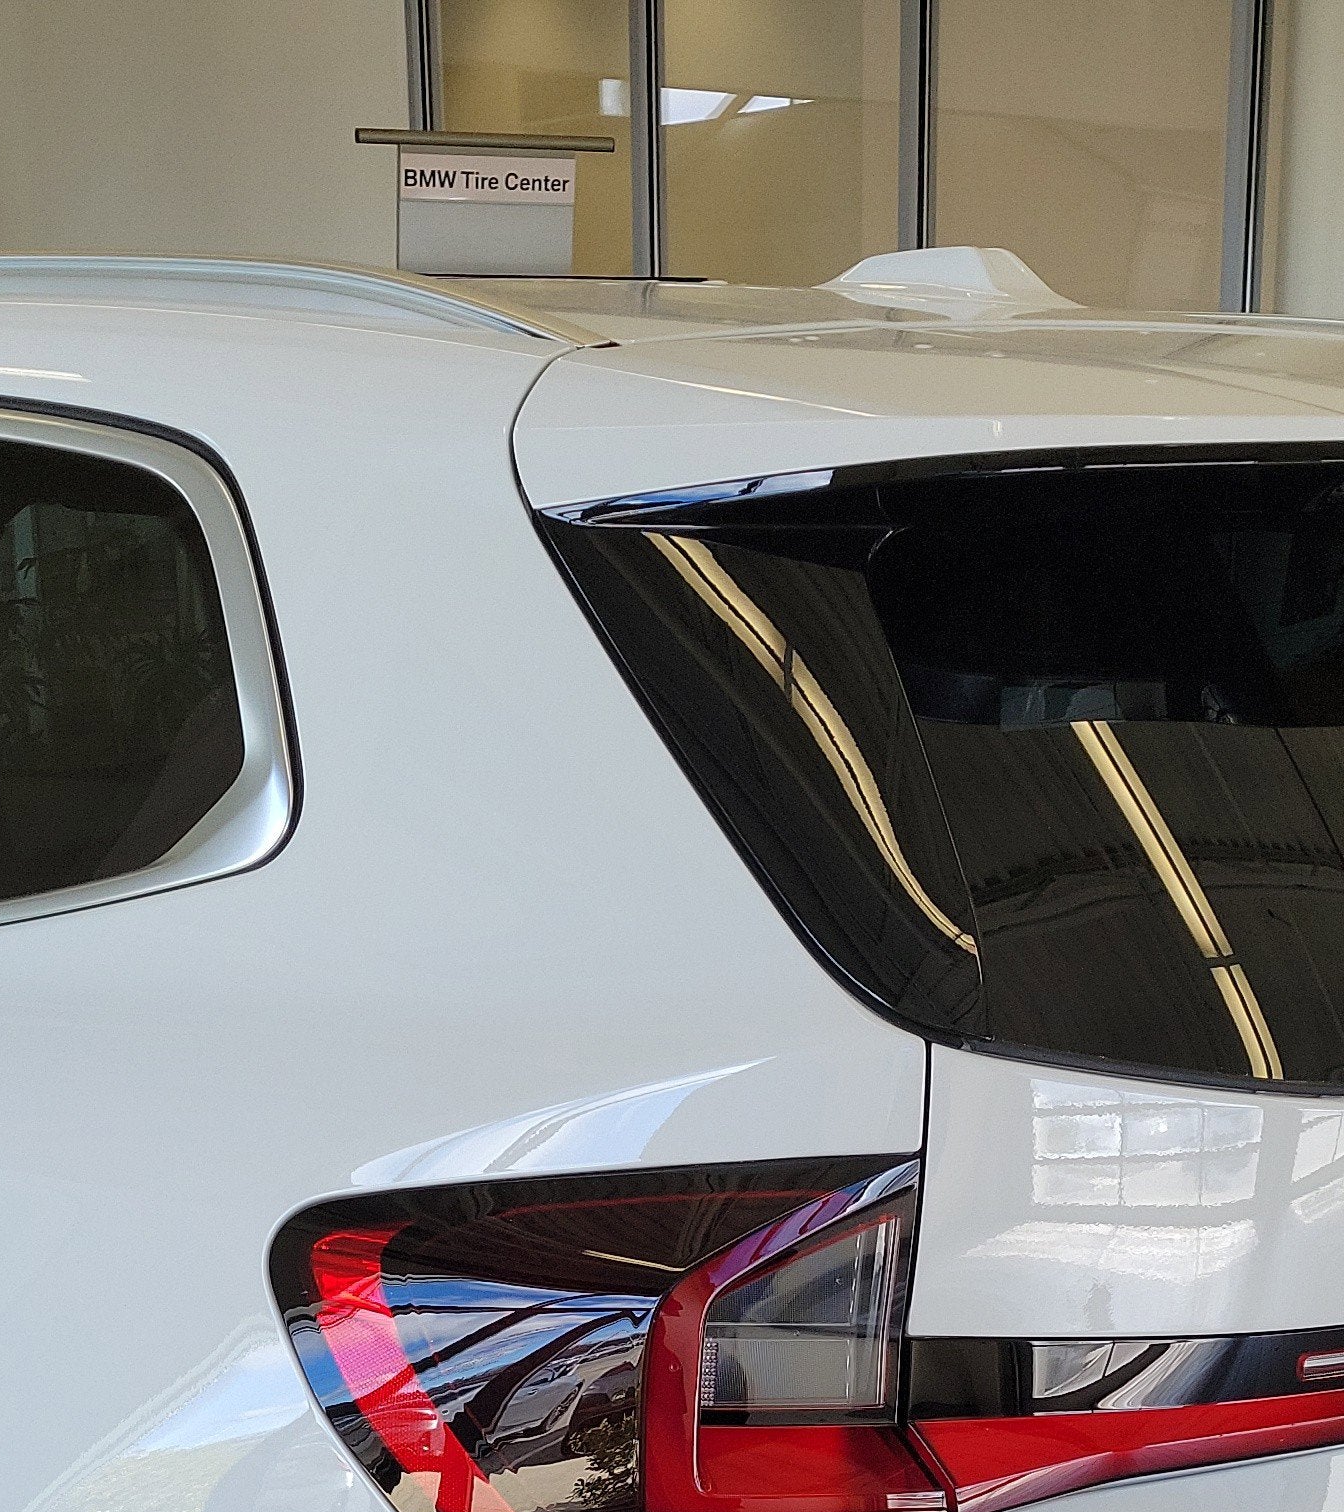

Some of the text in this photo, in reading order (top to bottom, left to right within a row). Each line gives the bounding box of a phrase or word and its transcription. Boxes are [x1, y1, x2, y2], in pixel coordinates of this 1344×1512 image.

[404, 169, 570, 192] BMW Tire Center
